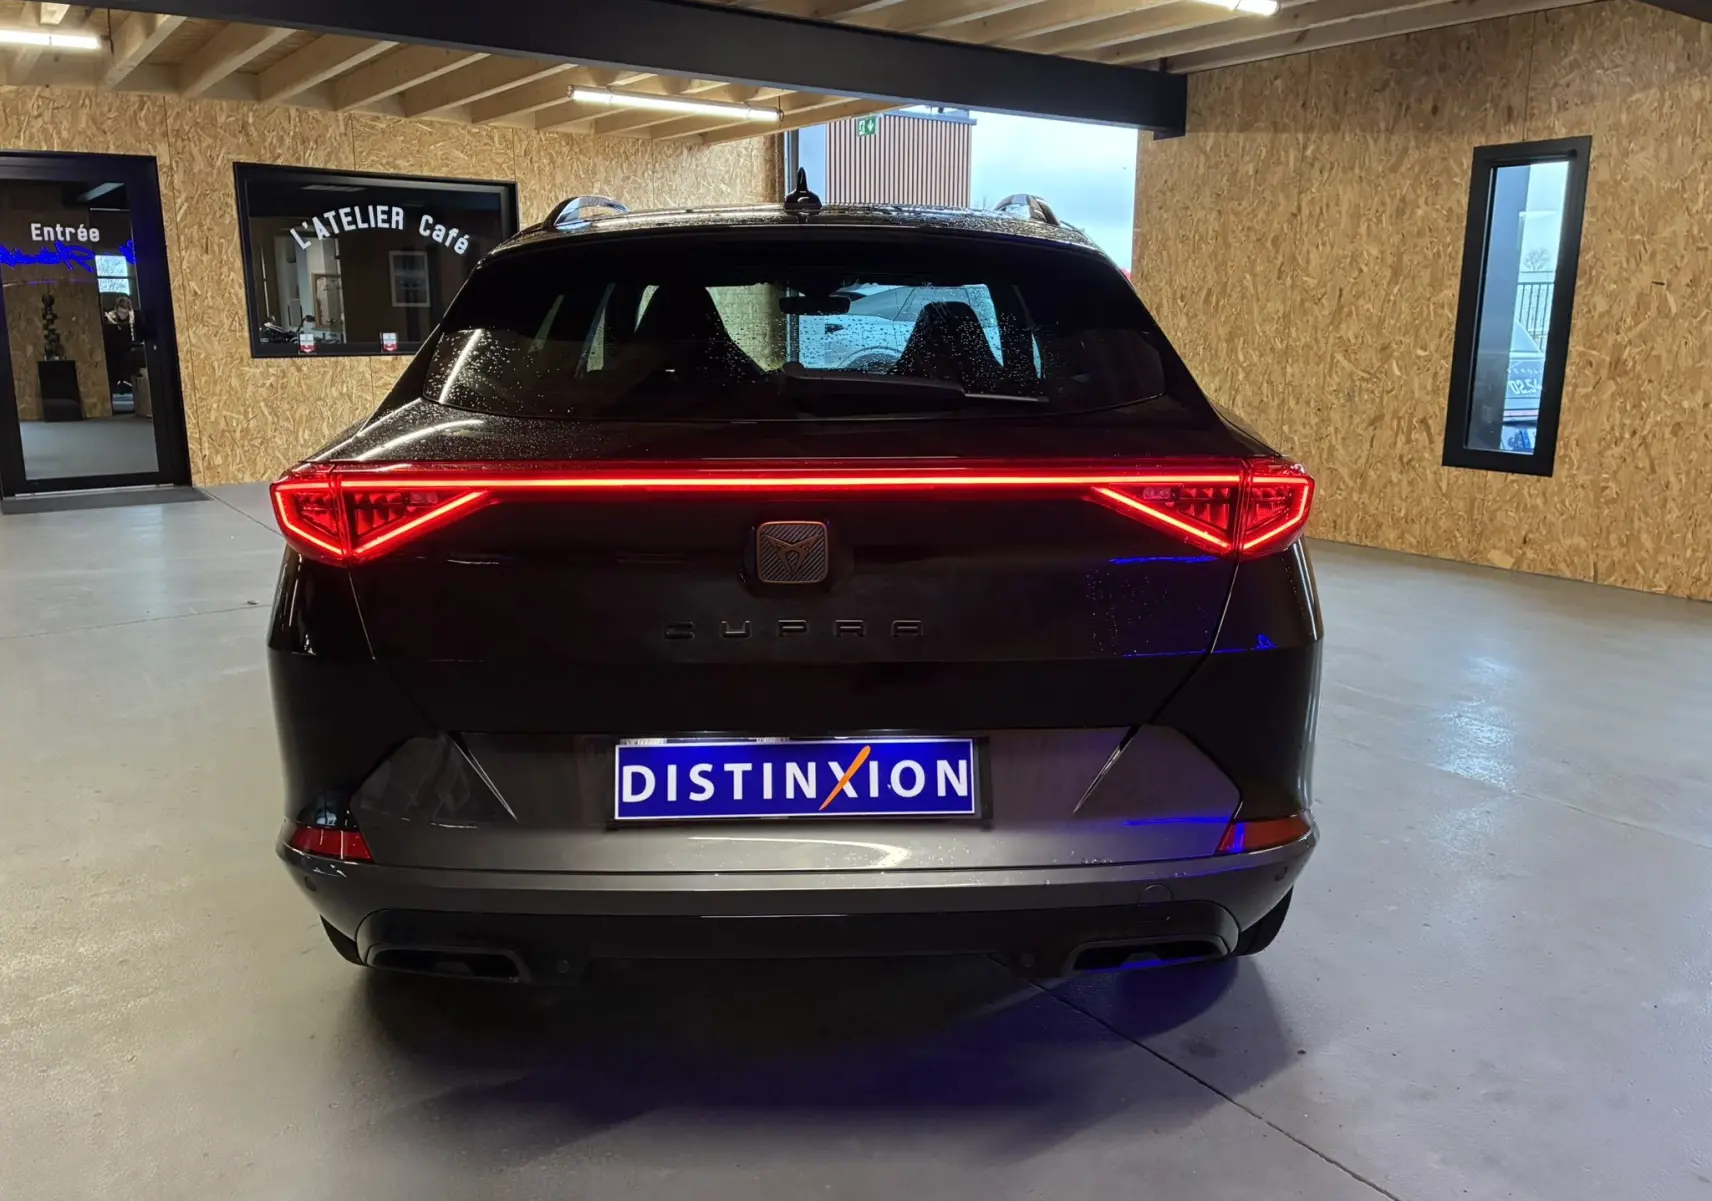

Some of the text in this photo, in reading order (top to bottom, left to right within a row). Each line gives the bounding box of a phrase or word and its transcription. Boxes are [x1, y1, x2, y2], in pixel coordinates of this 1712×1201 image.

[30, 223, 100, 242] Entrée
[290, 205, 470, 255] L'ATELIER Café
[664, 619, 924, 639] CUPRA
[621, 745, 968, 811] DISTINXION
